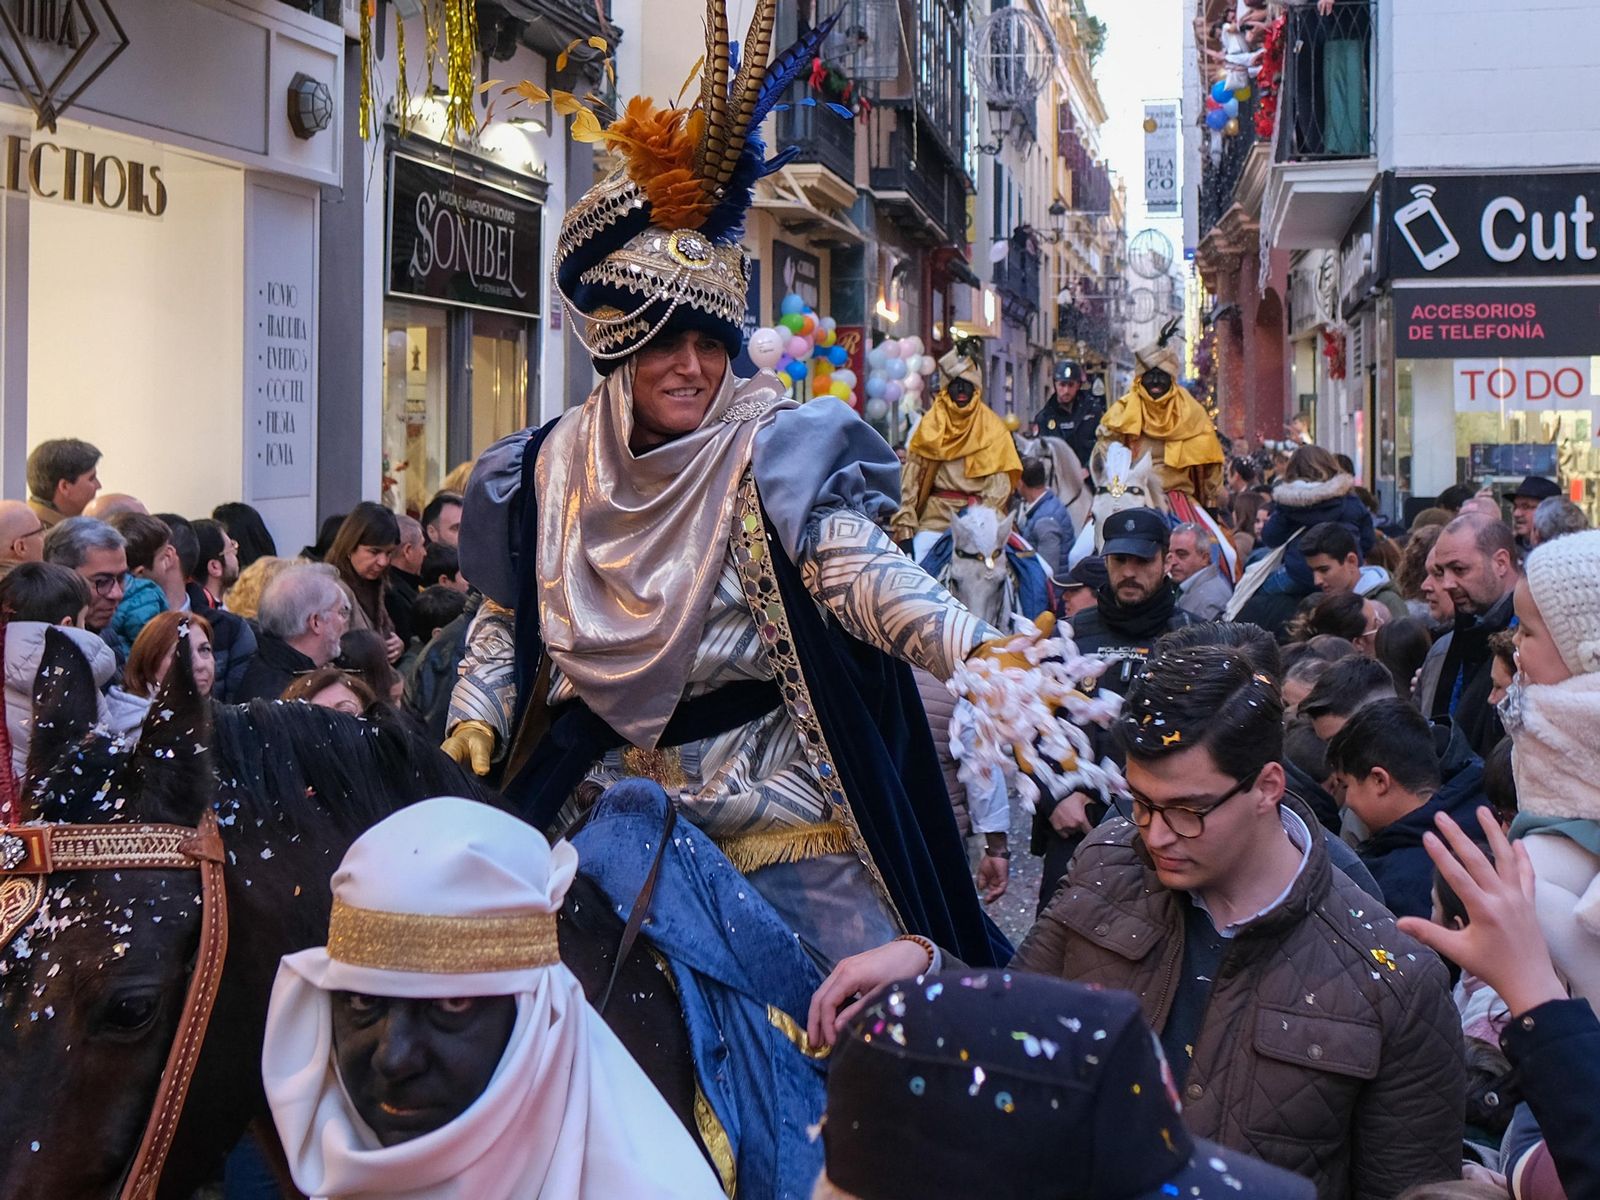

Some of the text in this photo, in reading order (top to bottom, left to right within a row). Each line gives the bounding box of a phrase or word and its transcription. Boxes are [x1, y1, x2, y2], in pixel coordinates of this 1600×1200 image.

[0, 134, 168, 217] ECTIONS
[1147, 158, 1174, 170] FLA
[1147, 178, 1174, 190] CO
[1480, 194, 1598, 263] Cut
[409, 191, 527, 299] SONIBEL
[1411, 303, 1537, 320] ACCESORIOS
[1408, 320, 1545, 341] DE TELEFONÍA
[266, 378, 304, 403] COCTEL
[1460, 367, 1584, 401] TODO
[266, 411, 295, 434] FIESTA
[1098, 653, 1148, 661] NACONAL
